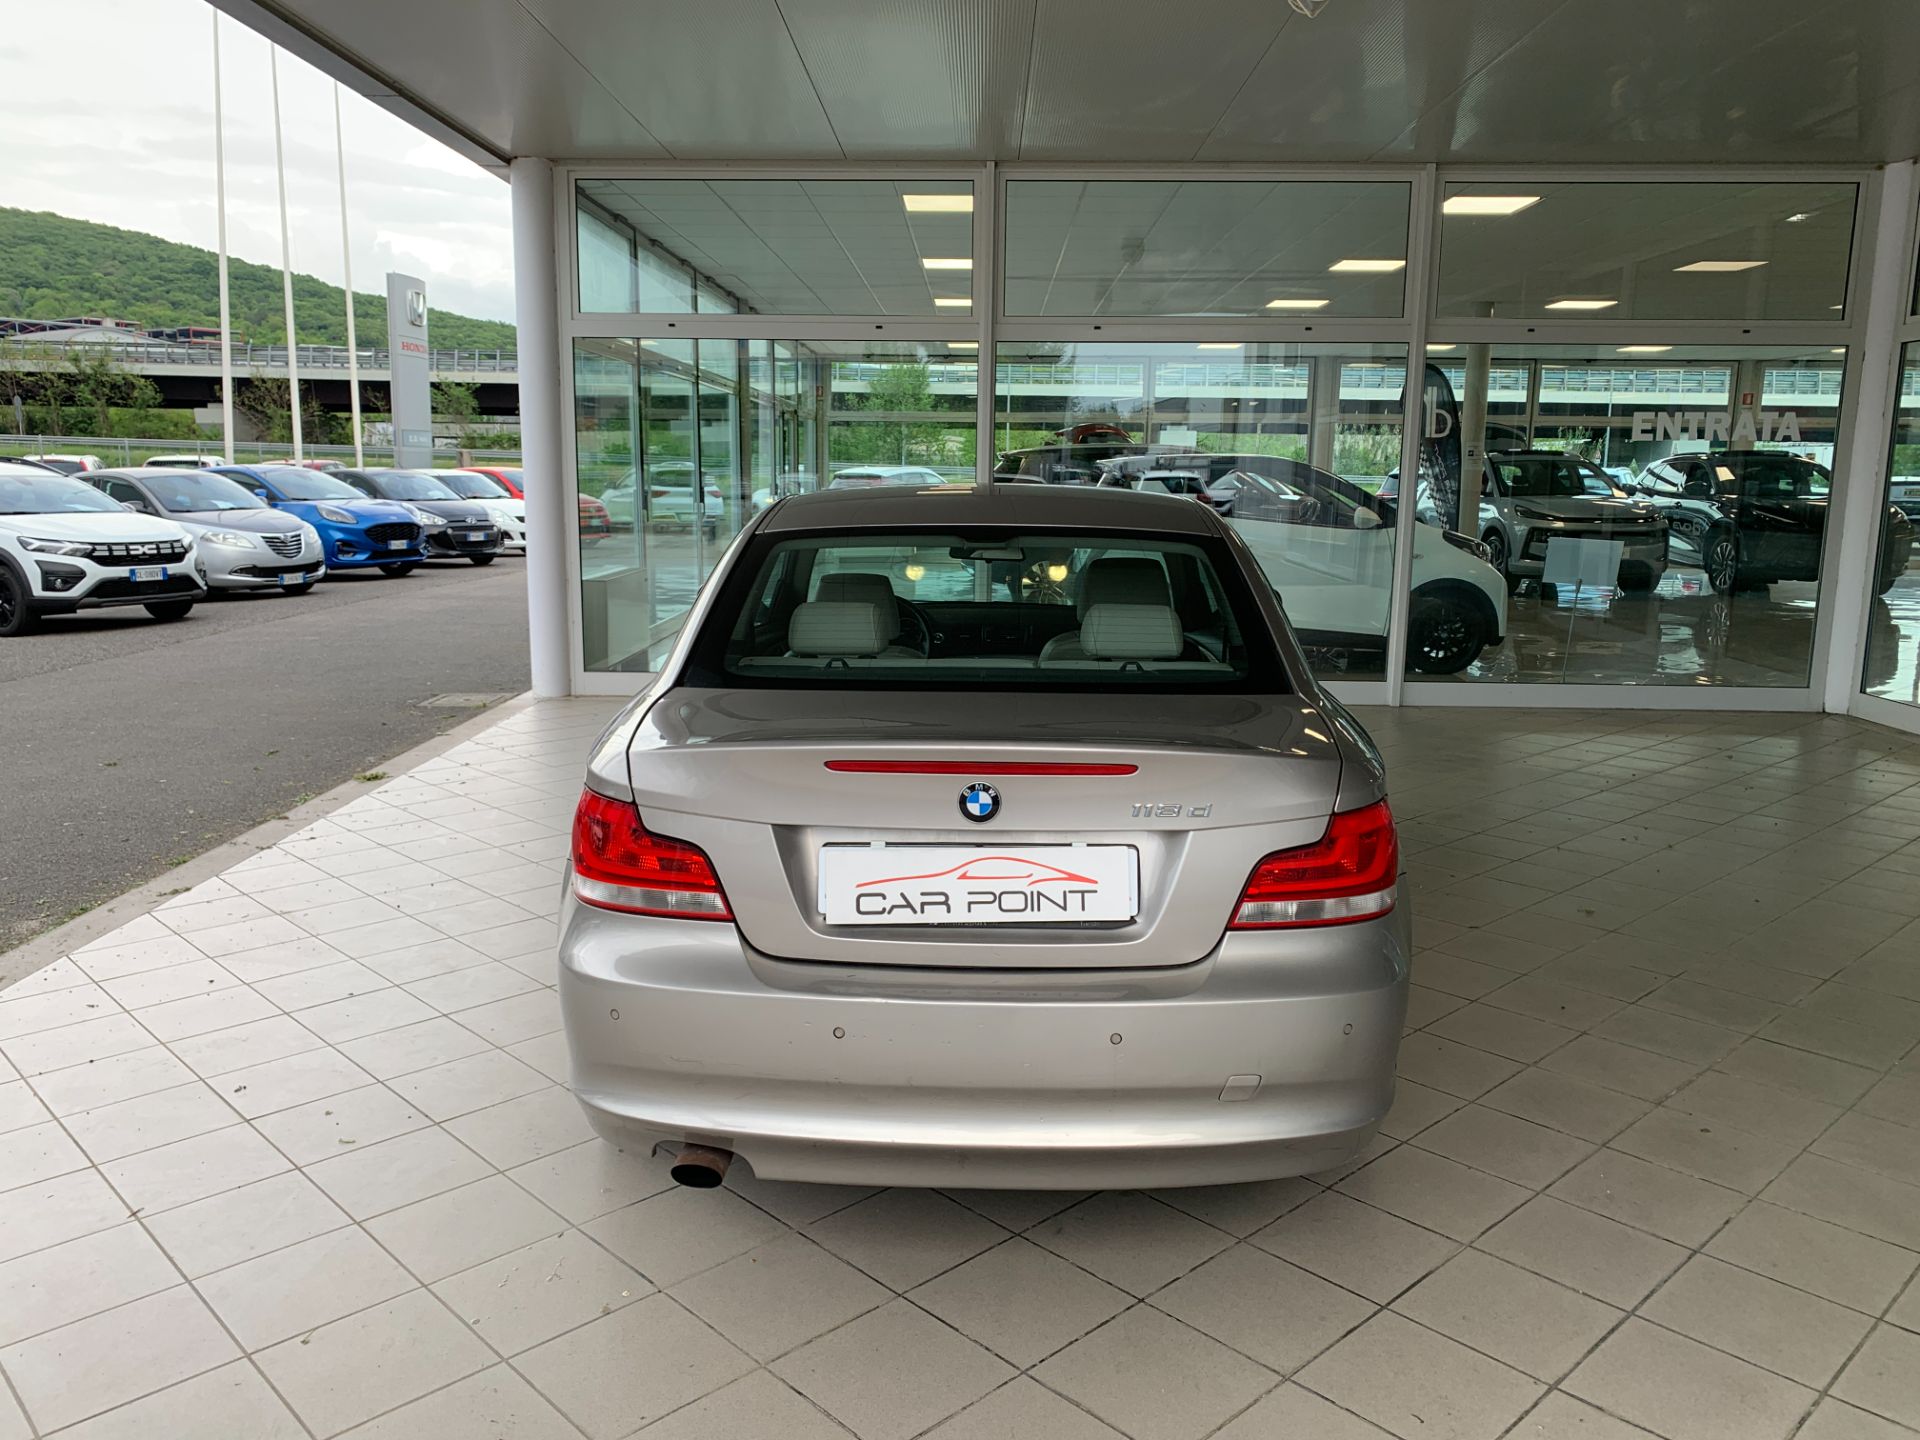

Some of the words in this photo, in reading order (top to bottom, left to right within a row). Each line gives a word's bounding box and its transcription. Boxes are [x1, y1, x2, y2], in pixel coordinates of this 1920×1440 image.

[1631, 411, 1802, 442] ENTRATA
[856, 892, 951, 916] CAR
[967, 890, 1098, 914] POINT
